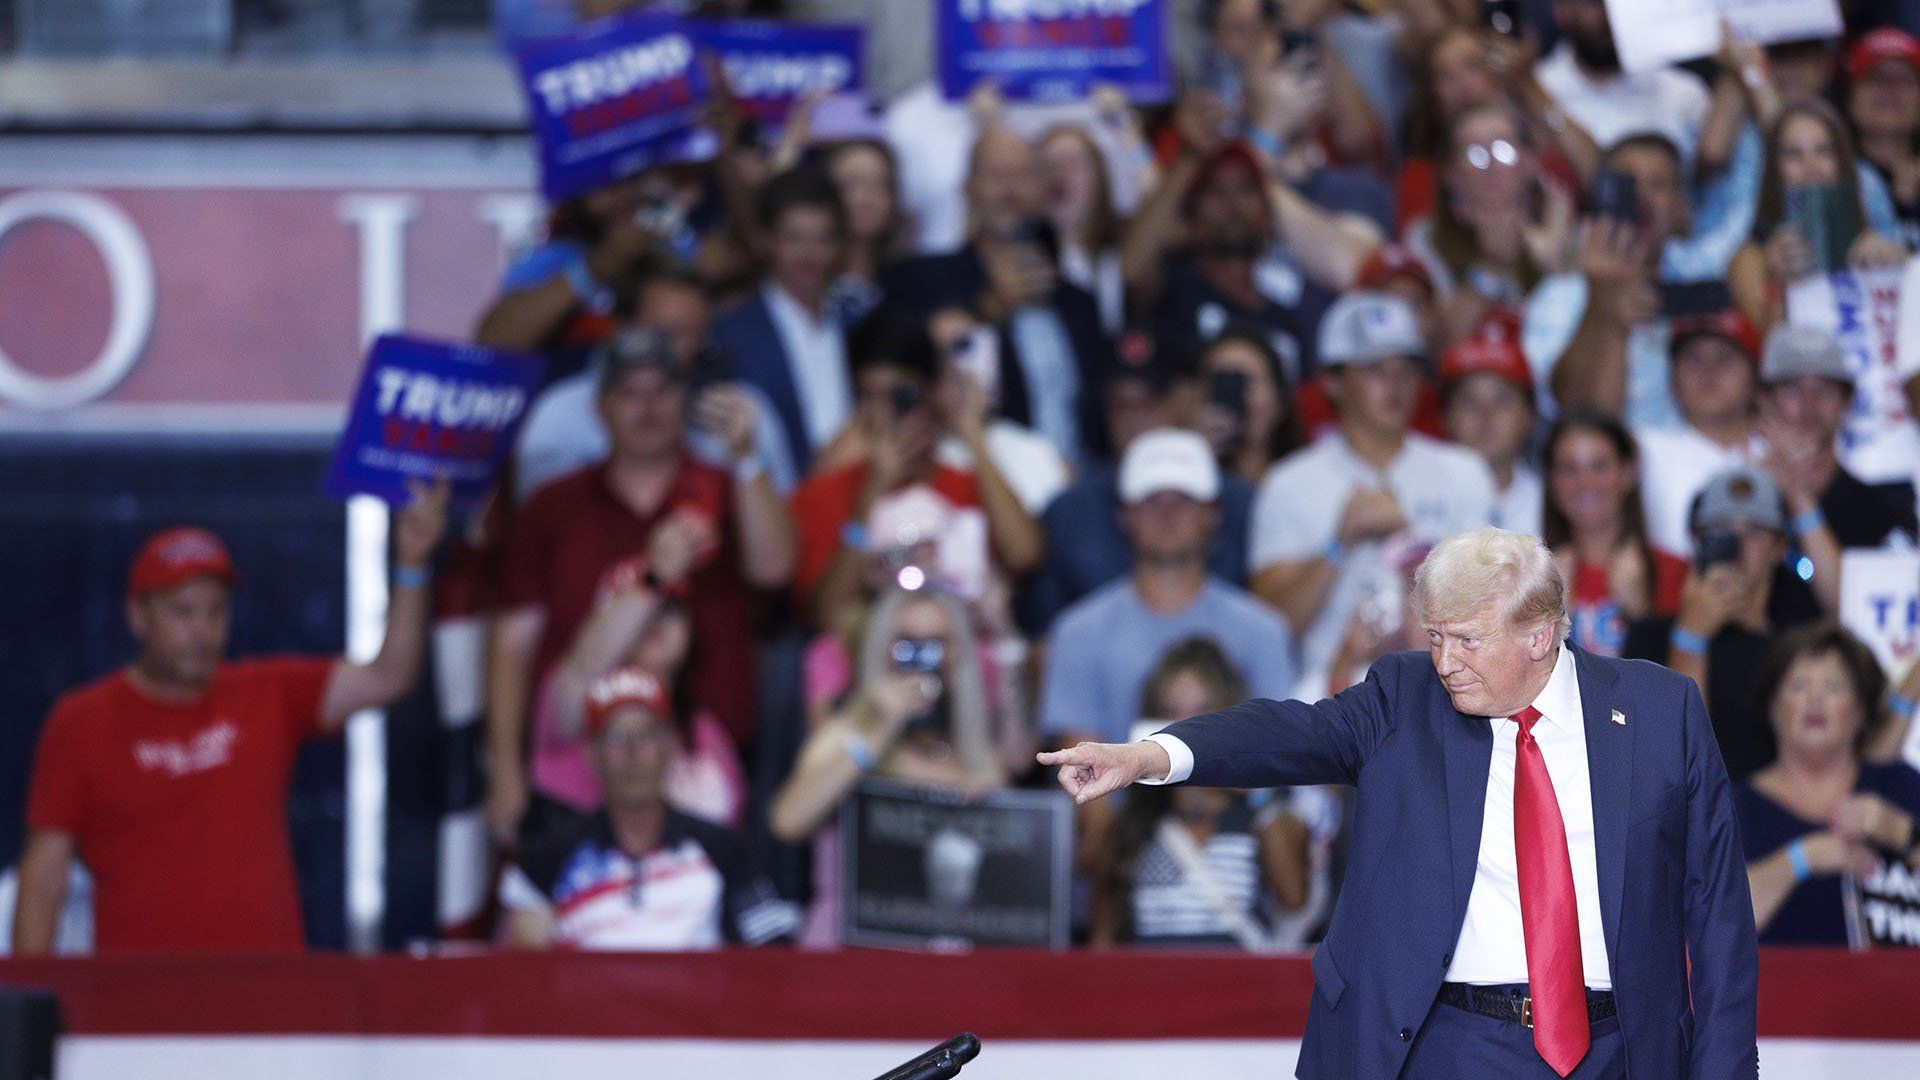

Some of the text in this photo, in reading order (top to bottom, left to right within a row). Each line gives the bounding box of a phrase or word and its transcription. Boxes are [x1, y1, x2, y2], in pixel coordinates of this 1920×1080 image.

[533, 32, 695, 119] TRUMP
[722, 52, 850, 98] UMP
[375, 364, 528, 432] TRUMP
